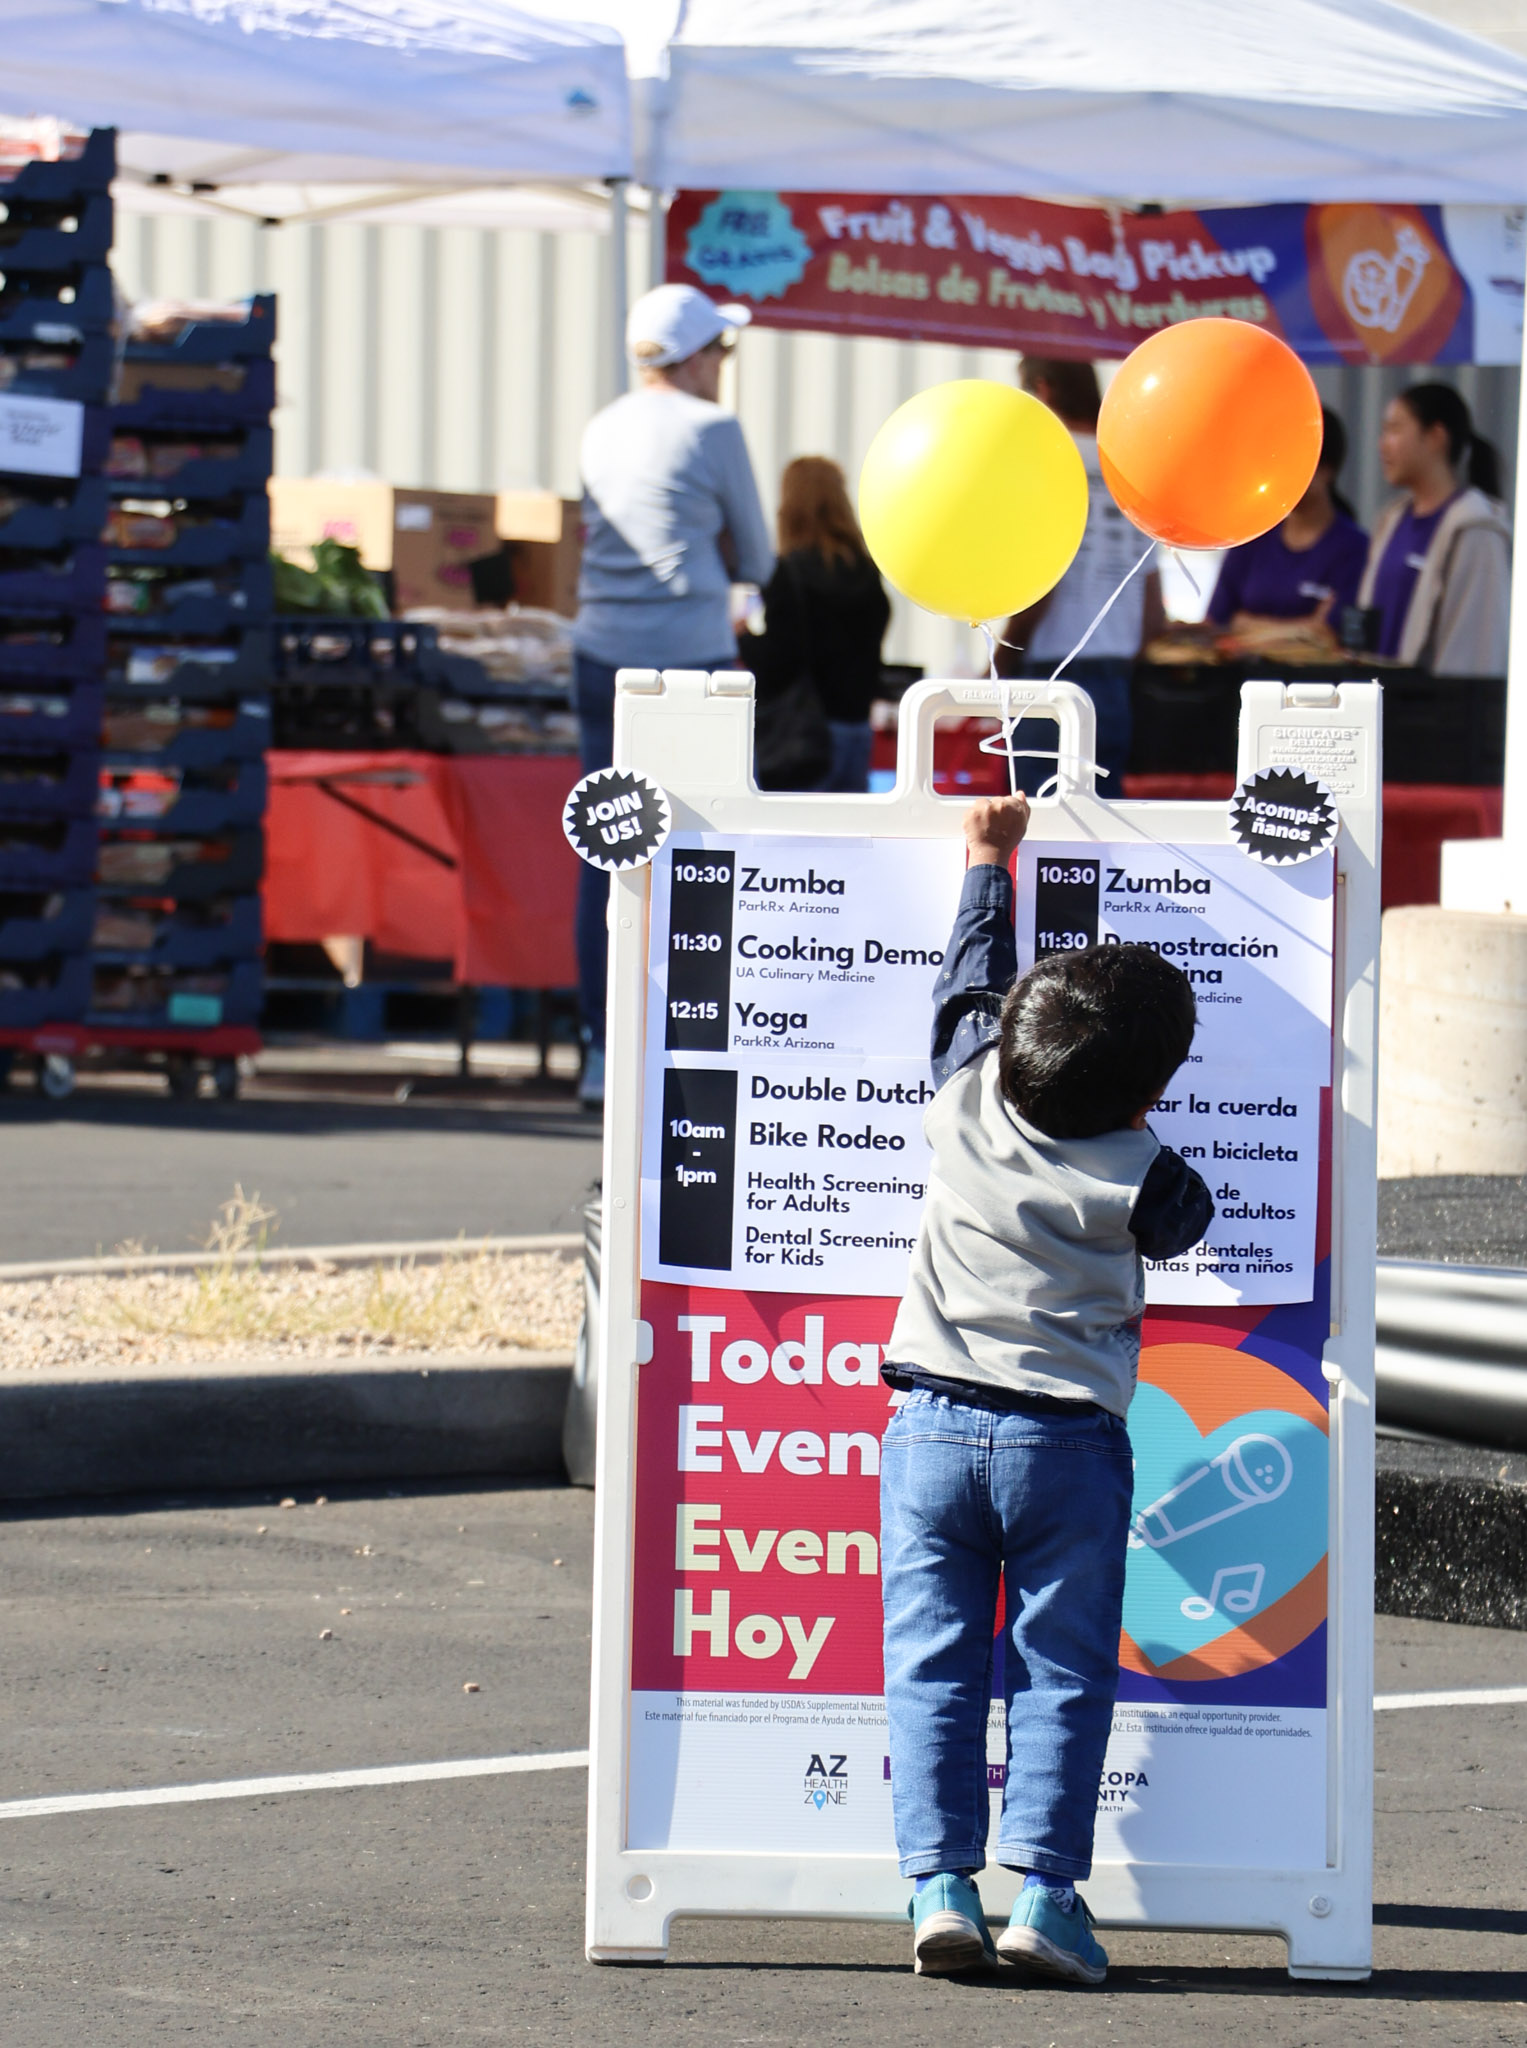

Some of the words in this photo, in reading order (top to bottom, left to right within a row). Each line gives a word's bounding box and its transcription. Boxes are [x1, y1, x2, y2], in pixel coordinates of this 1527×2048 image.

[817, 201, 917, 246] Fruit
[923, 204, 958, 249] &
[961, 211, 1064, 275] Veggie
[1062, 236, 1139, 291] Bag
[1140, 240, 1276, 284] Pickup
[828, 251, 930, 299] Bolsas
[937, 264, 979, 304] de
[988, 268, 1085, 317] Frutas
[1088, 296, 1107, 329] y
[586, 791, 643, 826] JOIN
[1242, 797, 1327, 825] Acompá-
[600, 817, 643, 845] US!
[1252, 817, 1311, 842] ñanos
[674, 865, 731, 884] 10:30
[740, 867, 845, 896] Zumba
[1040, 866, 1096, 885] 10:30
[1104, 868, 1211, 895] Zumba
[738, 901, 785, 915] ParkRx
[789, 902, 840, 916] Arizona
[1103, 901, 1151, 914] ParkRx
[1154, 902, 1206, 915] Arizona
[1038, 931, 1089, 950] 11:30
[672, 933, 722, 952] 11:30
[737, 935, 854, 969] Cooking
[864, 939, 943, 966] Demo
[736, 966, 755, 978] UA
[759, 967, 814, 983] Culinary
[818, 970, 875, 984] Medicine
[1193, 992, 1243, 1004] edicine
[670, 1001, 718, 1020] 12:15
[735, 1002, 808, 1035] Yoga
[733, 1036, 780, 1049] ParkRx
[784, 1037, 835, 1050] Arizona
[751, 1076, 847, 1101] Double
[856, 1079, 936, 1104] Dutch
[1190, 1094, 1210, 1113] la
[1218, 1097, 1298, 1117] cuerda
[669, 1119, 726, 1139] 10am
[750, 1122, 808, 1147] Bike
[817, 1124, 906, 1150] Rodeo
[1180, 1145, 1206, 1158] en
[1213, 1141, 1299, 1162] bicicleta
[675, 1164, 717, 1187] 1pm
[747, 1172, 815, 1190] Health
[1216, 1183, 1240, 1200] de
[746, 1193, 777, 1210] for
[783, 1194, 850, 1213] Adults
[1222, 1203, 1296, 1220] adultos
[746, 1226, 812, 1246] Dental
[745, 1246, 775, 1264] for
[781, 1248, 824, 1266] Kids
[1195, 1242, 1273, 1258] dentales
[1144, 1260, 1190, 1273] uitas
[1196, 1262, 1240, 1276] para
[1246, 1259, 1294, 1273] niños
[677, 1405, 880, 1476] Even
[675, 1504, 878, 1575] Even
[673, 1589, 836, 1680] Hoy
[676, 1697, 691, 1707] This
[692, 1698, 724, 1708] material
[725, 1700, 740, 1708] was
[742, 1699, 768, 1709] funded
[770, 1700, 779, 1711] by
[807, 1700, 859, 1711] Supplemental
[645, 1711, 660, 1720] Este
[662, 1711, 694, 1721] material
[695, 1712, 708, 1721] fue
[709, 1712, 748, 1723] financiado
[749, 1715, 762, 1725] por
[764, 1714, 771, 1723] el
[773, 1714, 808, 1725] Programa
[810, 1715, 820, 1725] de
[821, 1716, 845, 1726] Ayuda
[846, 1716, 856, 1725] de
[1120, 1709, 1159, 1719] institution
[1161, 1711, 1167, 1719] is
[1168, 1711, 1178, 1719] an
[1179, 1710, 1200, 1721] equal
[1202, 1712, 1247, 1723] opportunity
[1249, 1712, 1282, 1723] provider.
[1126, 1723, 1141, 1732] Esta
[1144, 1724, 1183, 1734] institución
[1185, 1725, 1207, 1734] ofrece
[1209, 1726, 1242, 1737] igualdad
[1244, 1727, 1253, 1735] de
[1255, 1727, 1312, 1738] oportunidades.
[805, 1754, 848, 1777] AZ
[804, 1779, 848, 1789] HEALTH
